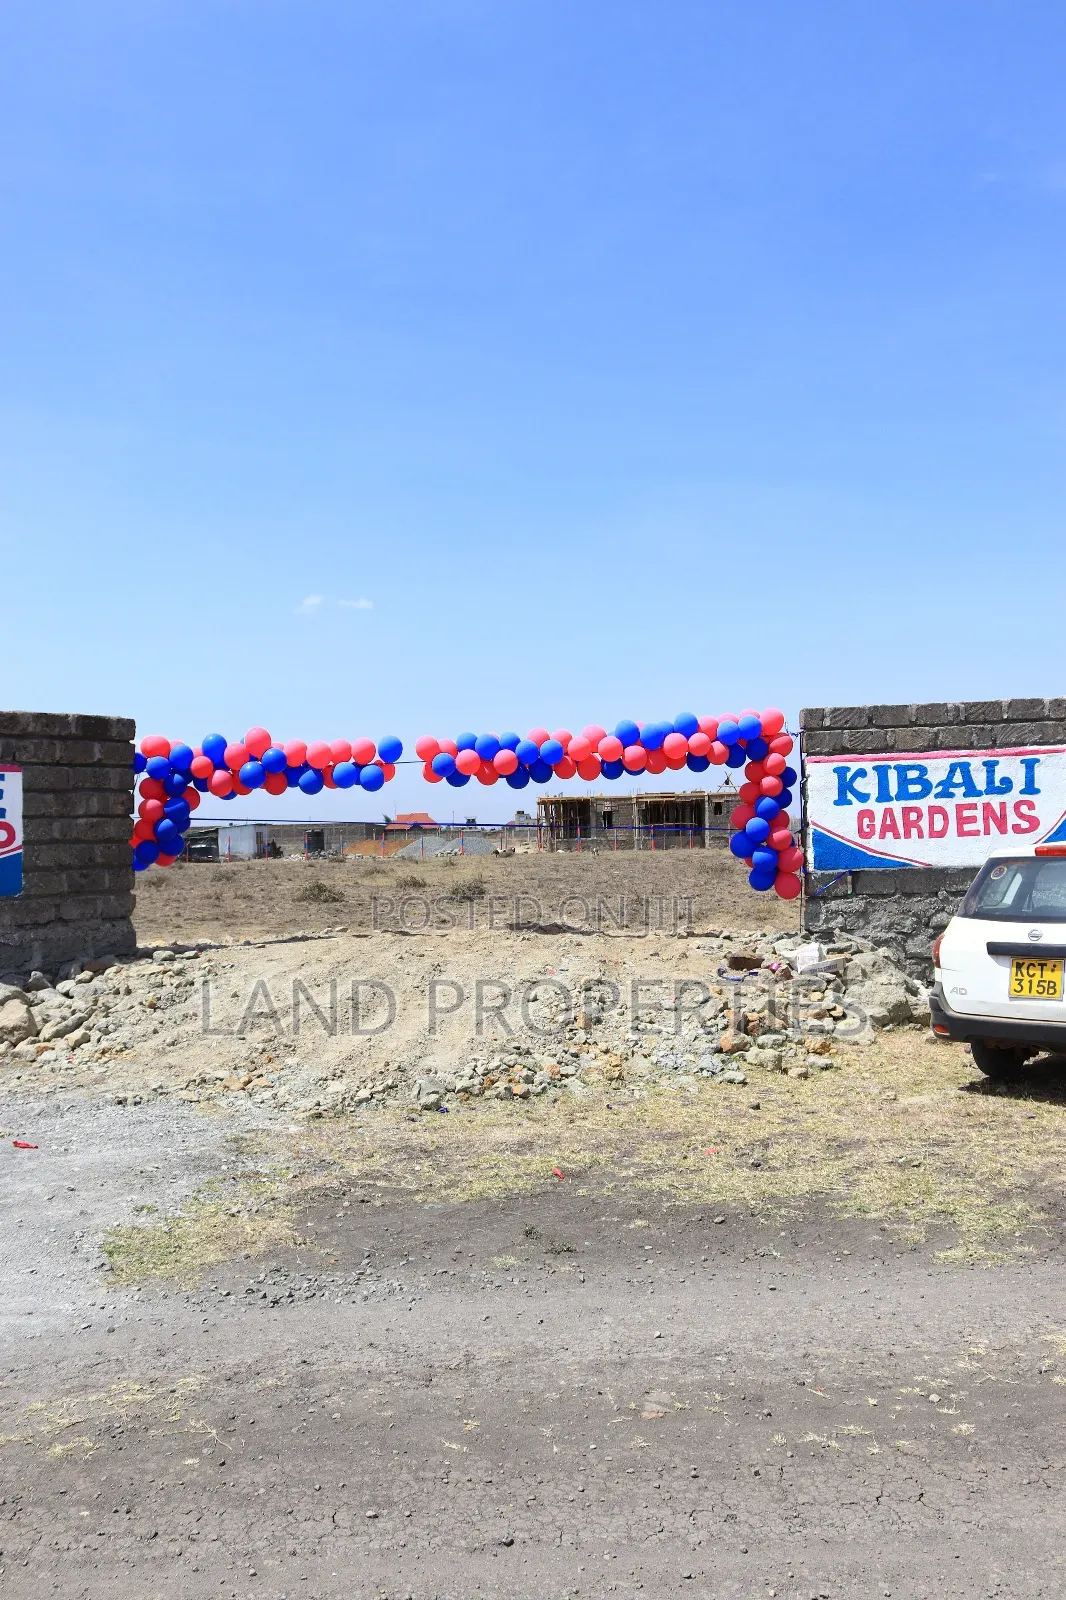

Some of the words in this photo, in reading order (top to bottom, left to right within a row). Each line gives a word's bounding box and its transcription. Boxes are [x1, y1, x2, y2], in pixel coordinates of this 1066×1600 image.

[833, 758, 1042, 806] KIBALI
[857, 800, 1041, 840] GARDENS
[1014, 961, 1048, 979] KCT
[949, 986, 968, 996] AD
[1013, 978, 1058, 996] 315B
